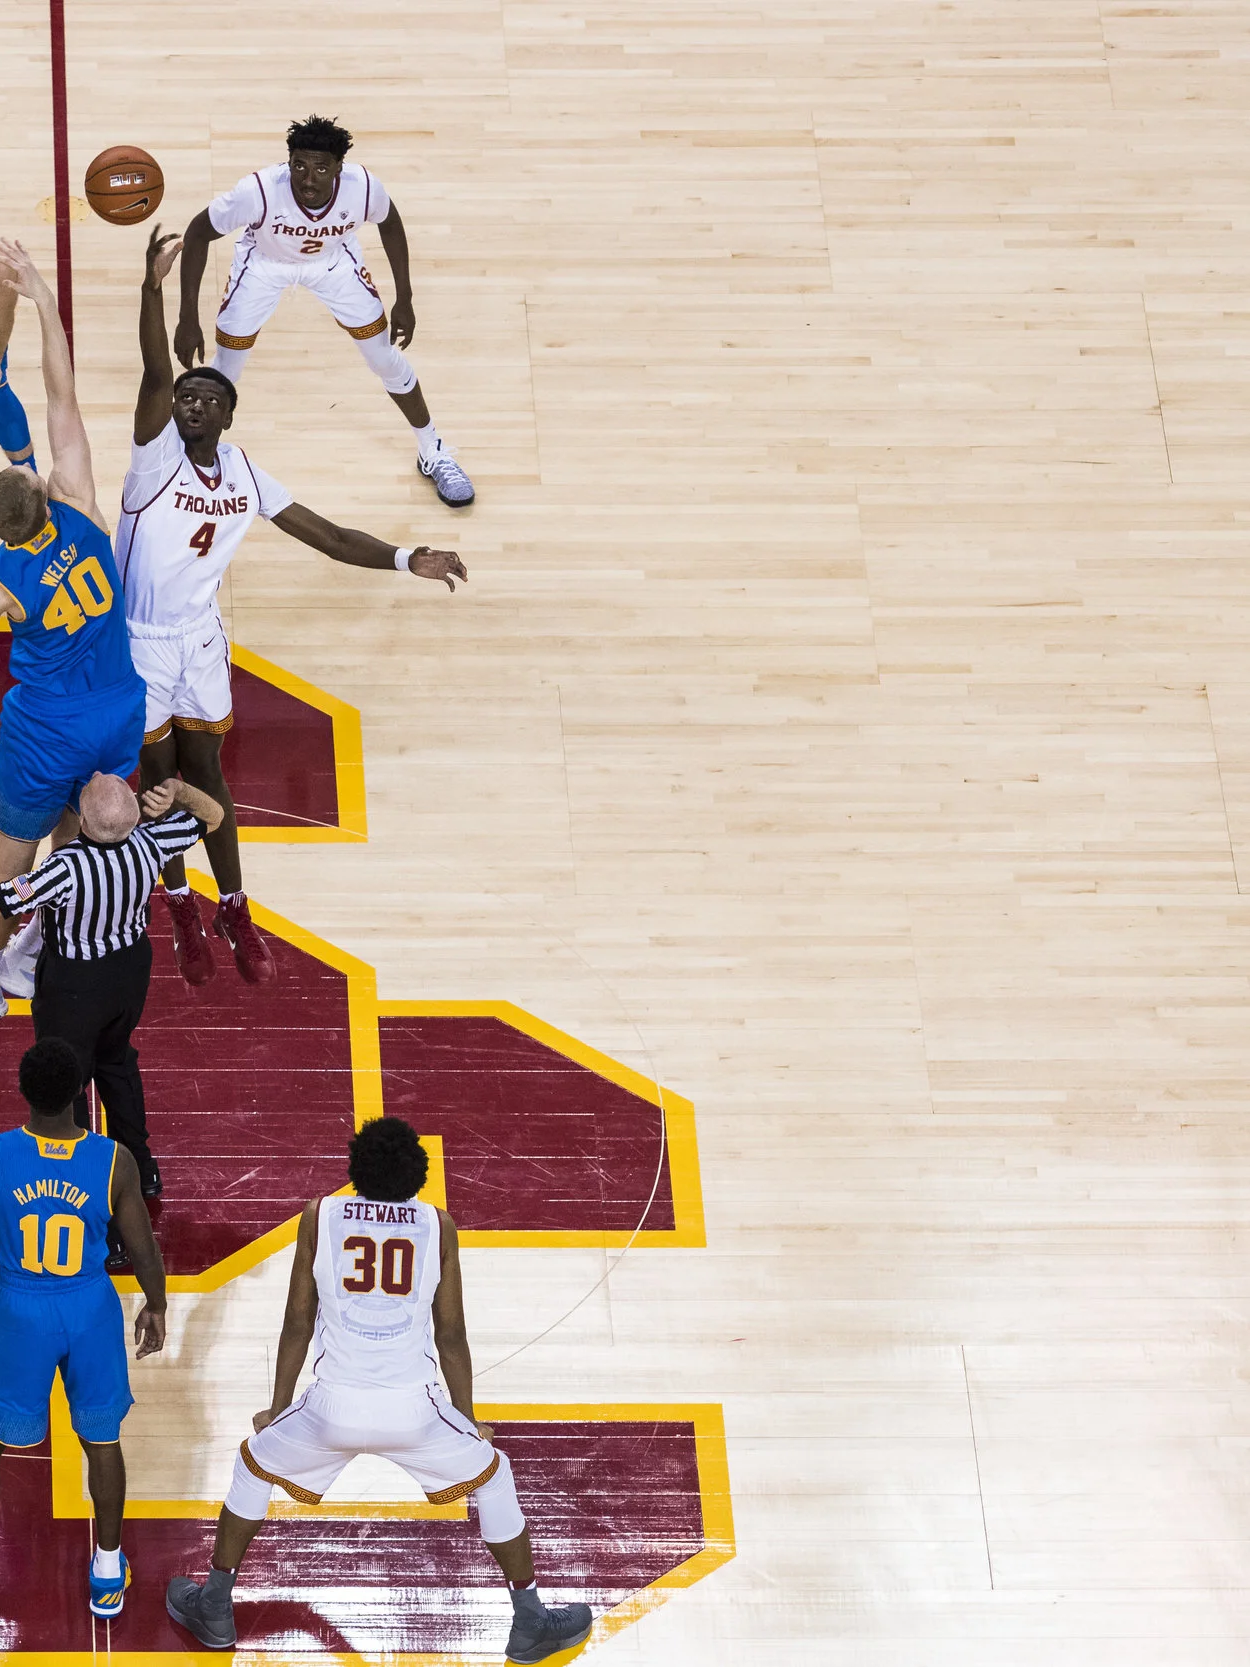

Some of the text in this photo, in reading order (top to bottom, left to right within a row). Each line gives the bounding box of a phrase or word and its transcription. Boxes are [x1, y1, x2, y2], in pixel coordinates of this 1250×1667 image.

[272, 221, 355, 238] TROJANS
[300, 239, 323, 254] 2
[174, 491, 248, 516] TROJANS
[189, 521, 216, 557] 4
[39, 543, 77, 587] WELSH
[42, 556, 114, 635] 40
[12, 1179, 90, 1209] HAMILTON
[343, 1202, 417, 1224] STEWART
[19, 1213, 85, 1277] 10
[342, 1235, 415, 1296] 30
